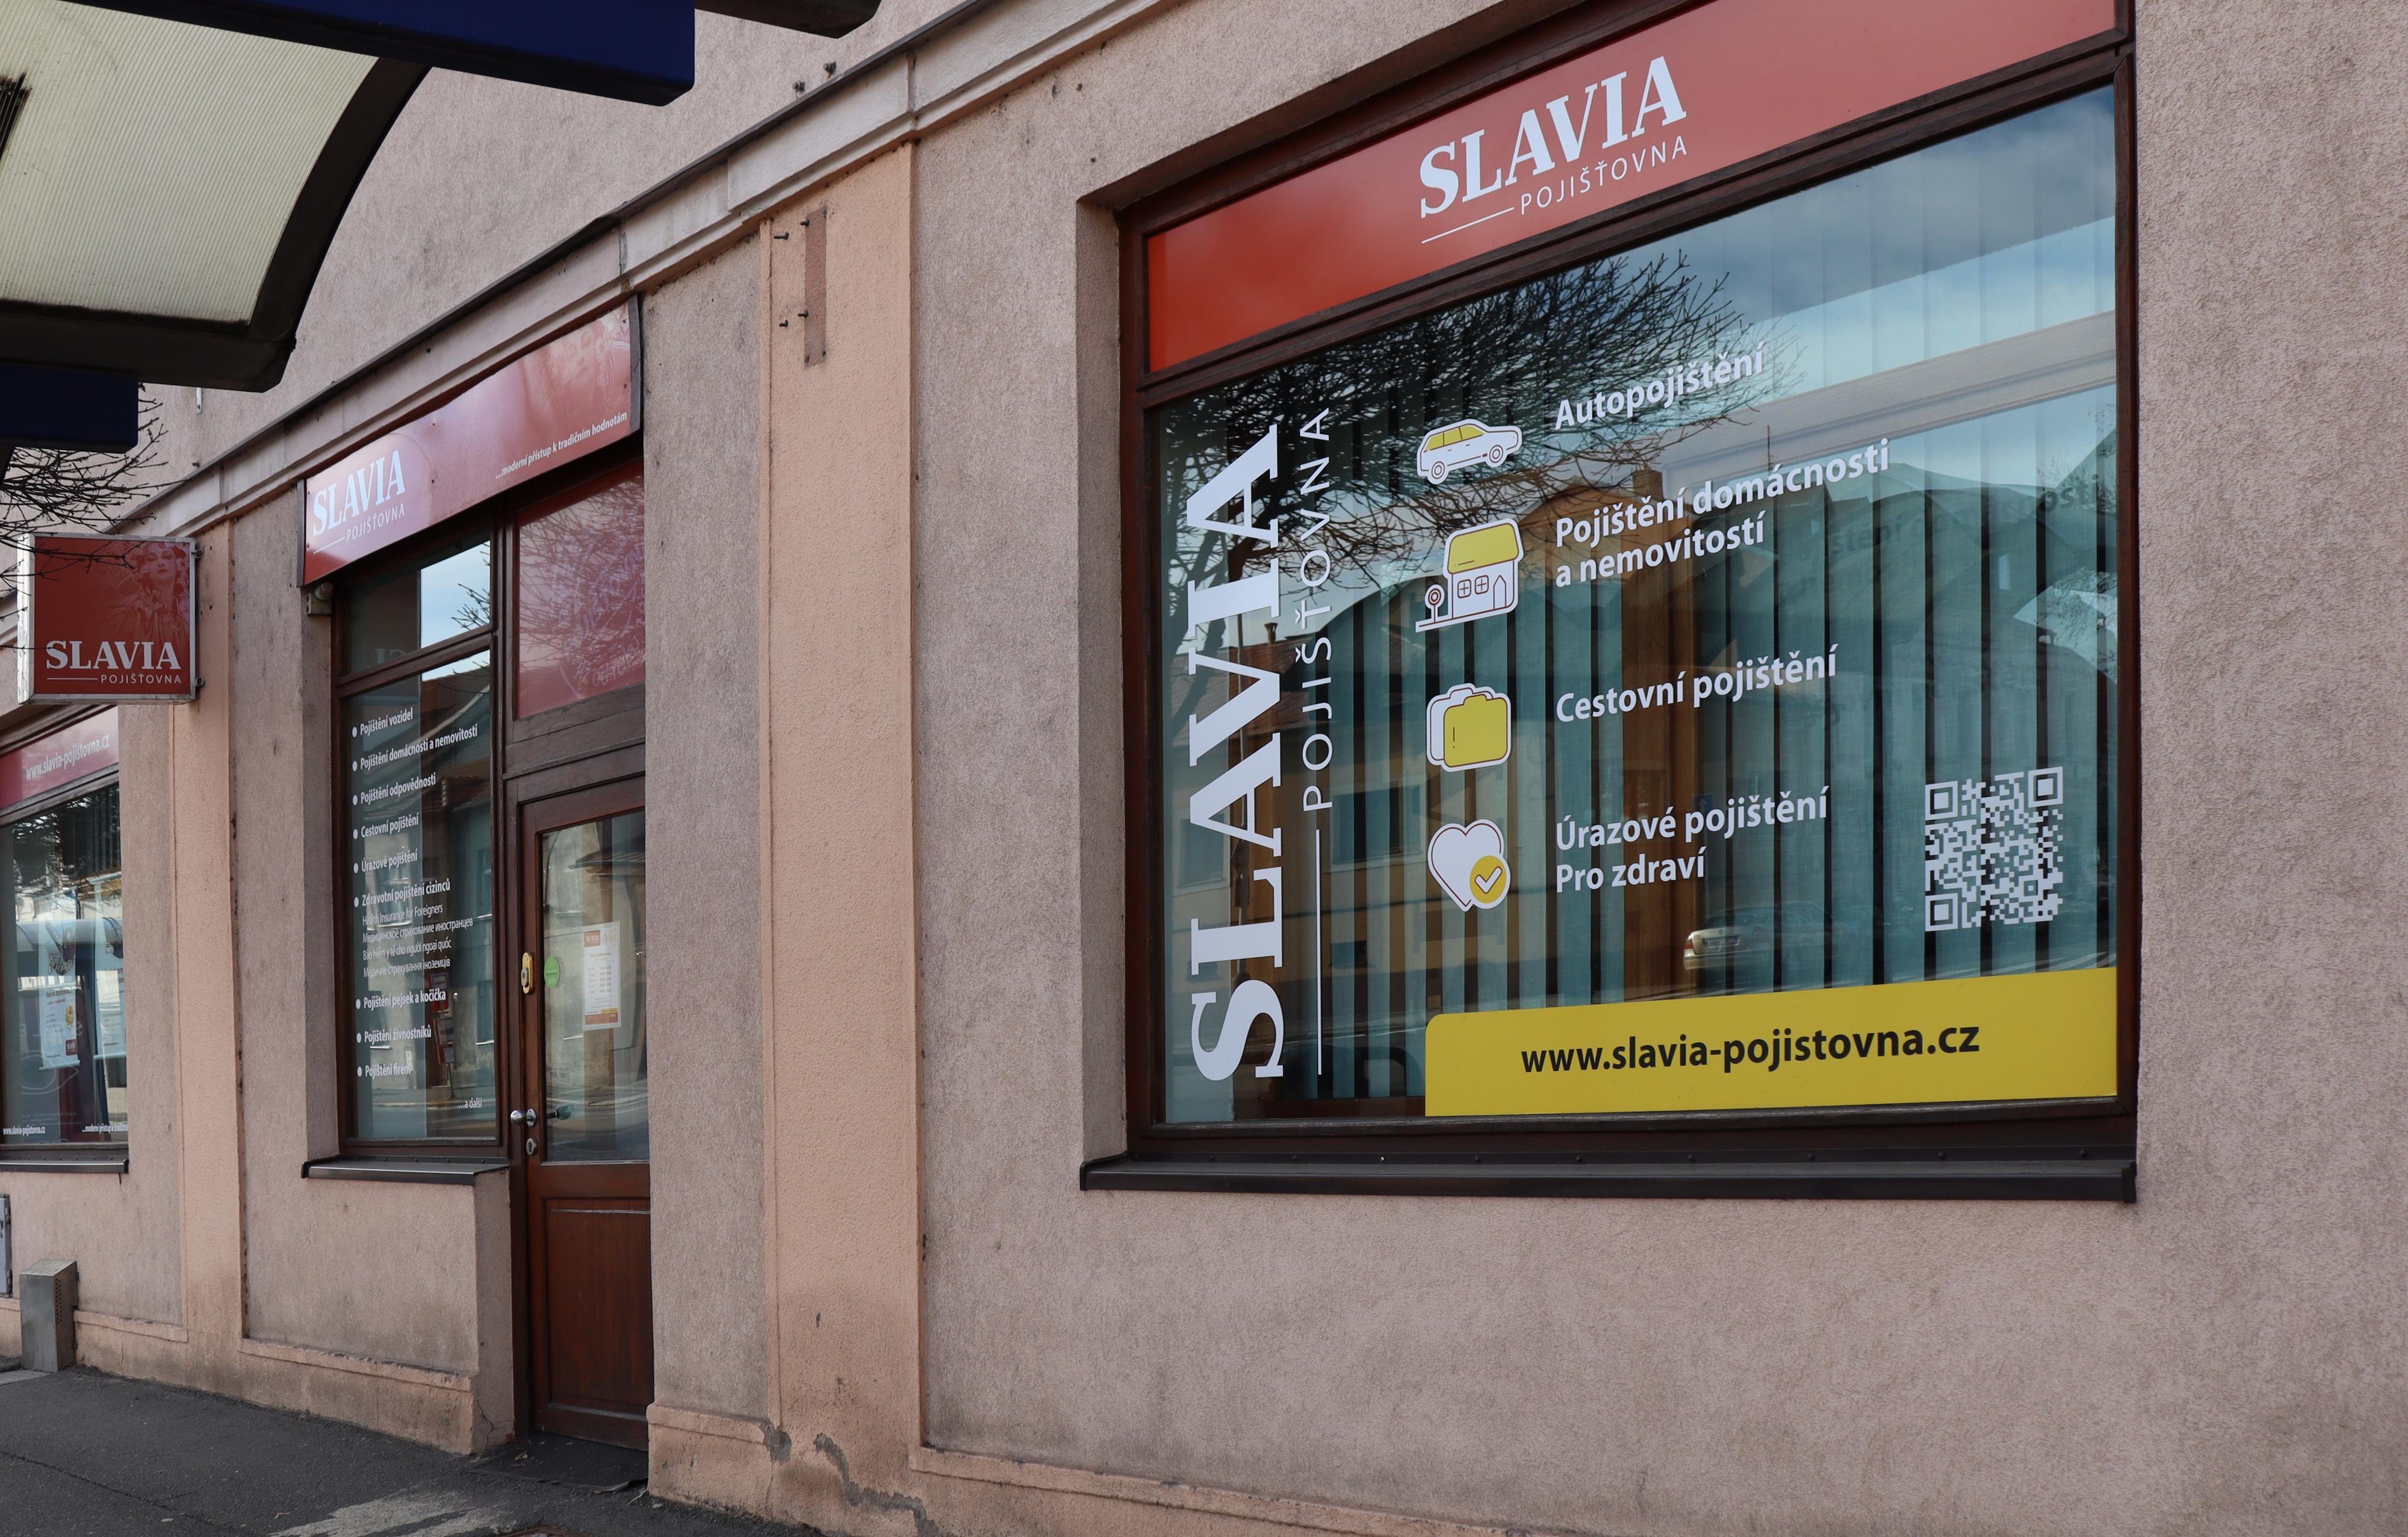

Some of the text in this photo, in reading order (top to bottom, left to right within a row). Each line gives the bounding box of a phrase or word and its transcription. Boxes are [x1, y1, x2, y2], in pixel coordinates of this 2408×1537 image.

[1420, 55, 1687, 219] SLAVIA
[1521, 135, 1687, 215] POJIŠŤOVNA
[1555, 341, 1767, 430] Autopojištění
[495, 412, 627, 479] ...moderní přístup k tradičním hodnotám
[312, 450, 405, 538] SLAVIA
[1556, 437, 1890, 548] Pojištění domácnosti
[346, 503, 405, 542] POJIŠŤOVNA
[1556, 511, 1766, 588] a nemovitostí
[1296, 407, 1332, 812] POJIŠŤOVNA
[46, 640, 181, 669] SLAVIA
[101, 674, 181, 684] POJIŠŤOVNA
[1556, 643, 1839, 722] Cestovní pojištění
[360, 707, 414, 736] Pojištění vozidel
[25, 734, 110, 780] www.slavia-pojistovna.cz
[360, 724, 477, 771] Pojištění domácnosti a nemovitosti
[1187, 424, 1284, 1081] SLAVIA
[361, 772, 436, 805] Pojištění odpovědnosti
[361, 812, 420, 838] Cestovní pojištění
[1556, 785, 1829, 851] Úrazové pojištění
[362, 848, 418, 872] Úrazové pojištění
[1557, 846, 1707, 893] Pro zdraví
[362, 878, 451, 907] Zdravotní pojištění cizinců
[362, 914, 379, 926] Health
[380, 911, 405, 923] Insurance
[414, 904, 443, 918] Foreigners
[363, 918, 473, 944] Медицинское страхование иностранцев
[388, 963, 422, 976] страхування
[423, 956, 451, 969] іноземців
[396, 943, 406, 955] cho
[364, 995, 391, 1011] Pojištění
[392, 992, 414, 1008] pejsek
[420, 988, 446, 1002] kočička
[364, 1024, 432, 1045] Pojištění živnostníků
[1521, 1025, 1981, 1073] www.slavia-pojistovna.cz
[365, 1064, 411, 1079] Pojištění firem
[468, 1098, 482, 1108] další
